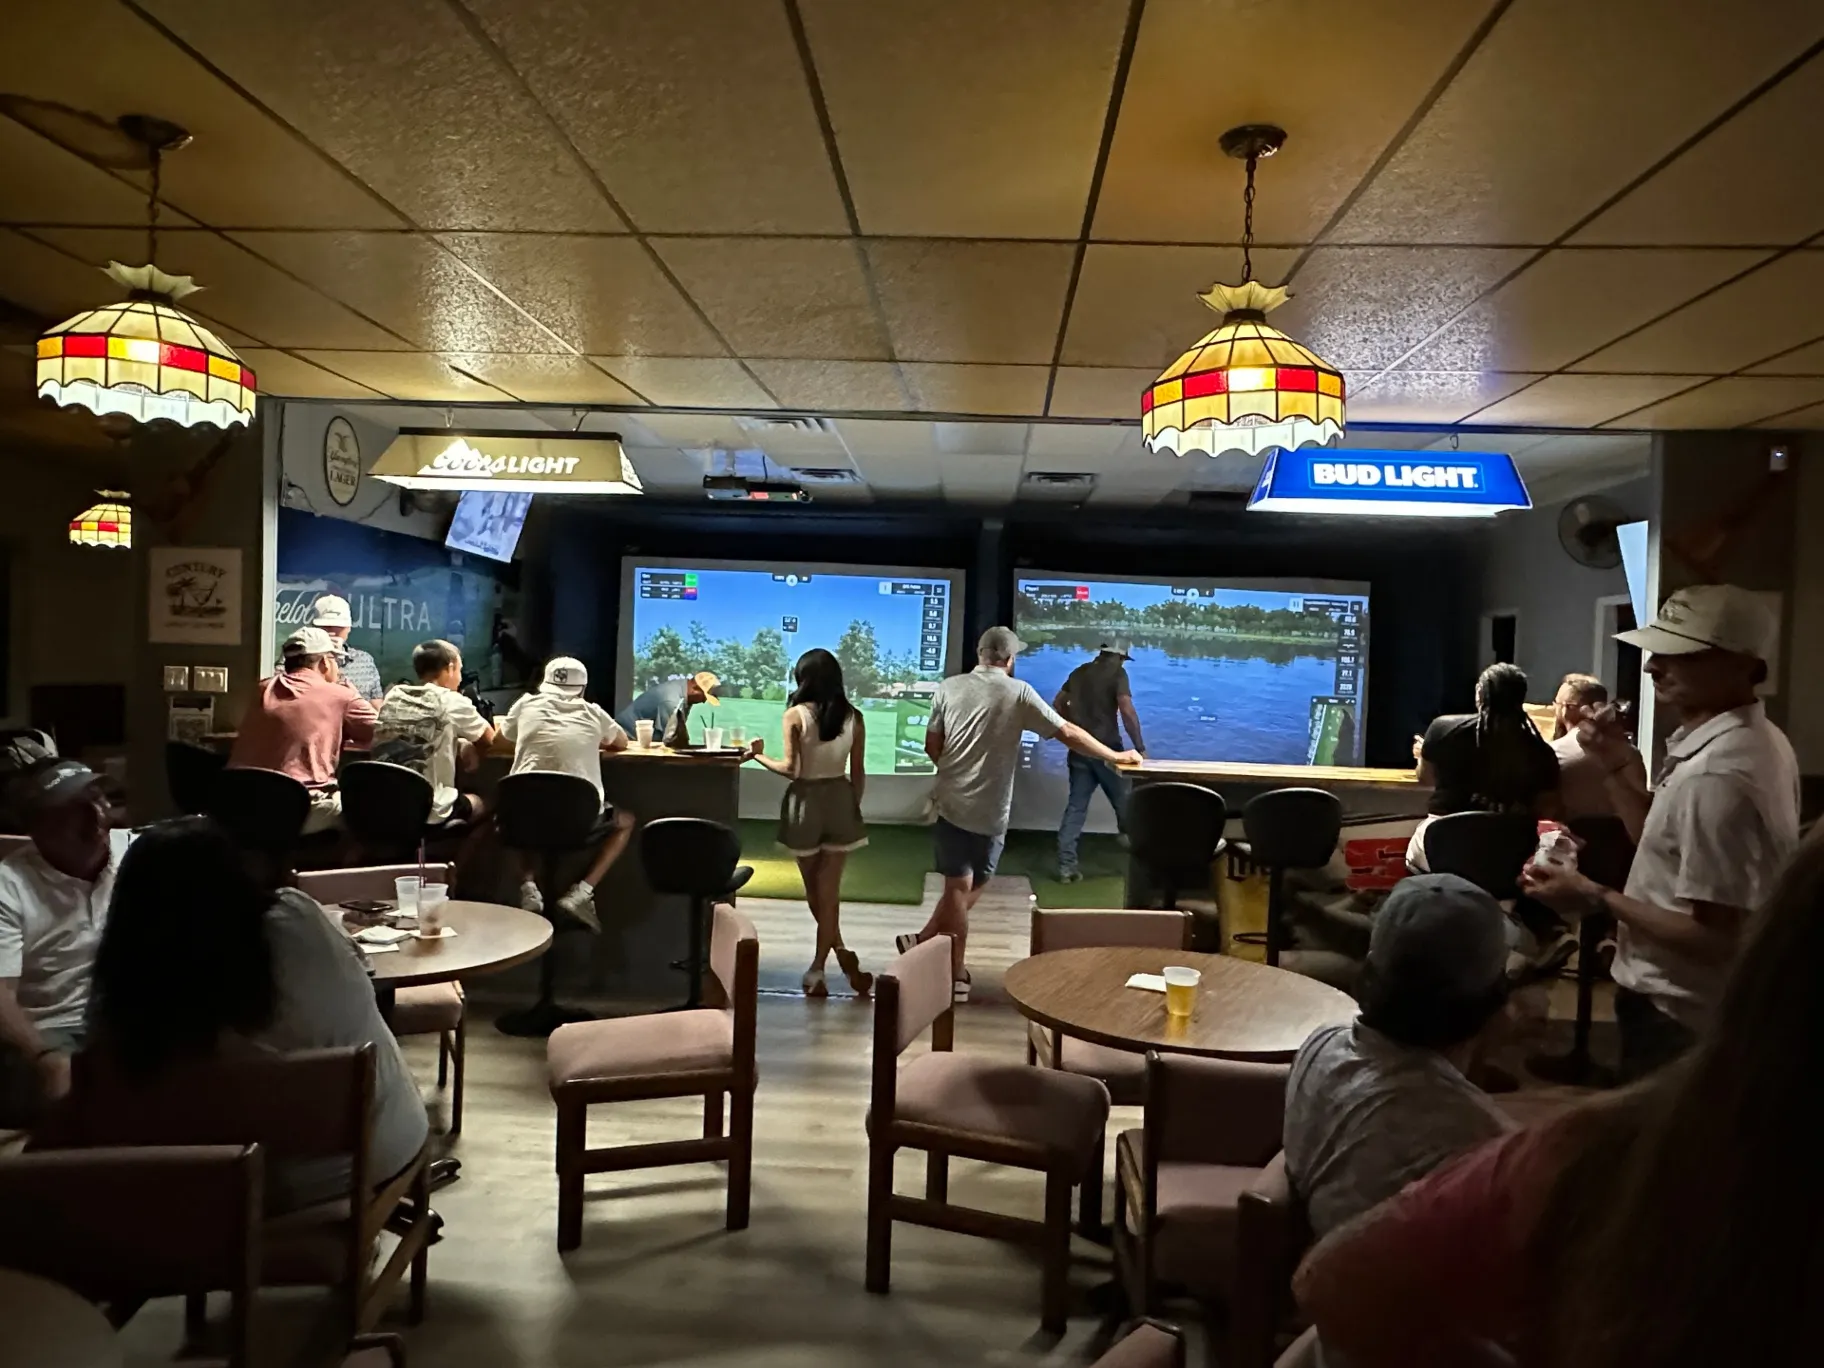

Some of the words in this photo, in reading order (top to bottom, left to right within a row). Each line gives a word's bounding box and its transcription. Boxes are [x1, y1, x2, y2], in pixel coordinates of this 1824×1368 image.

[507, 456, 580, 474] LIGHT
[1313, 464, 1382, 486] BUD
[1384, 465, 1479, 489] LIGHT
[348, 593, 431, 632] ULTRA
